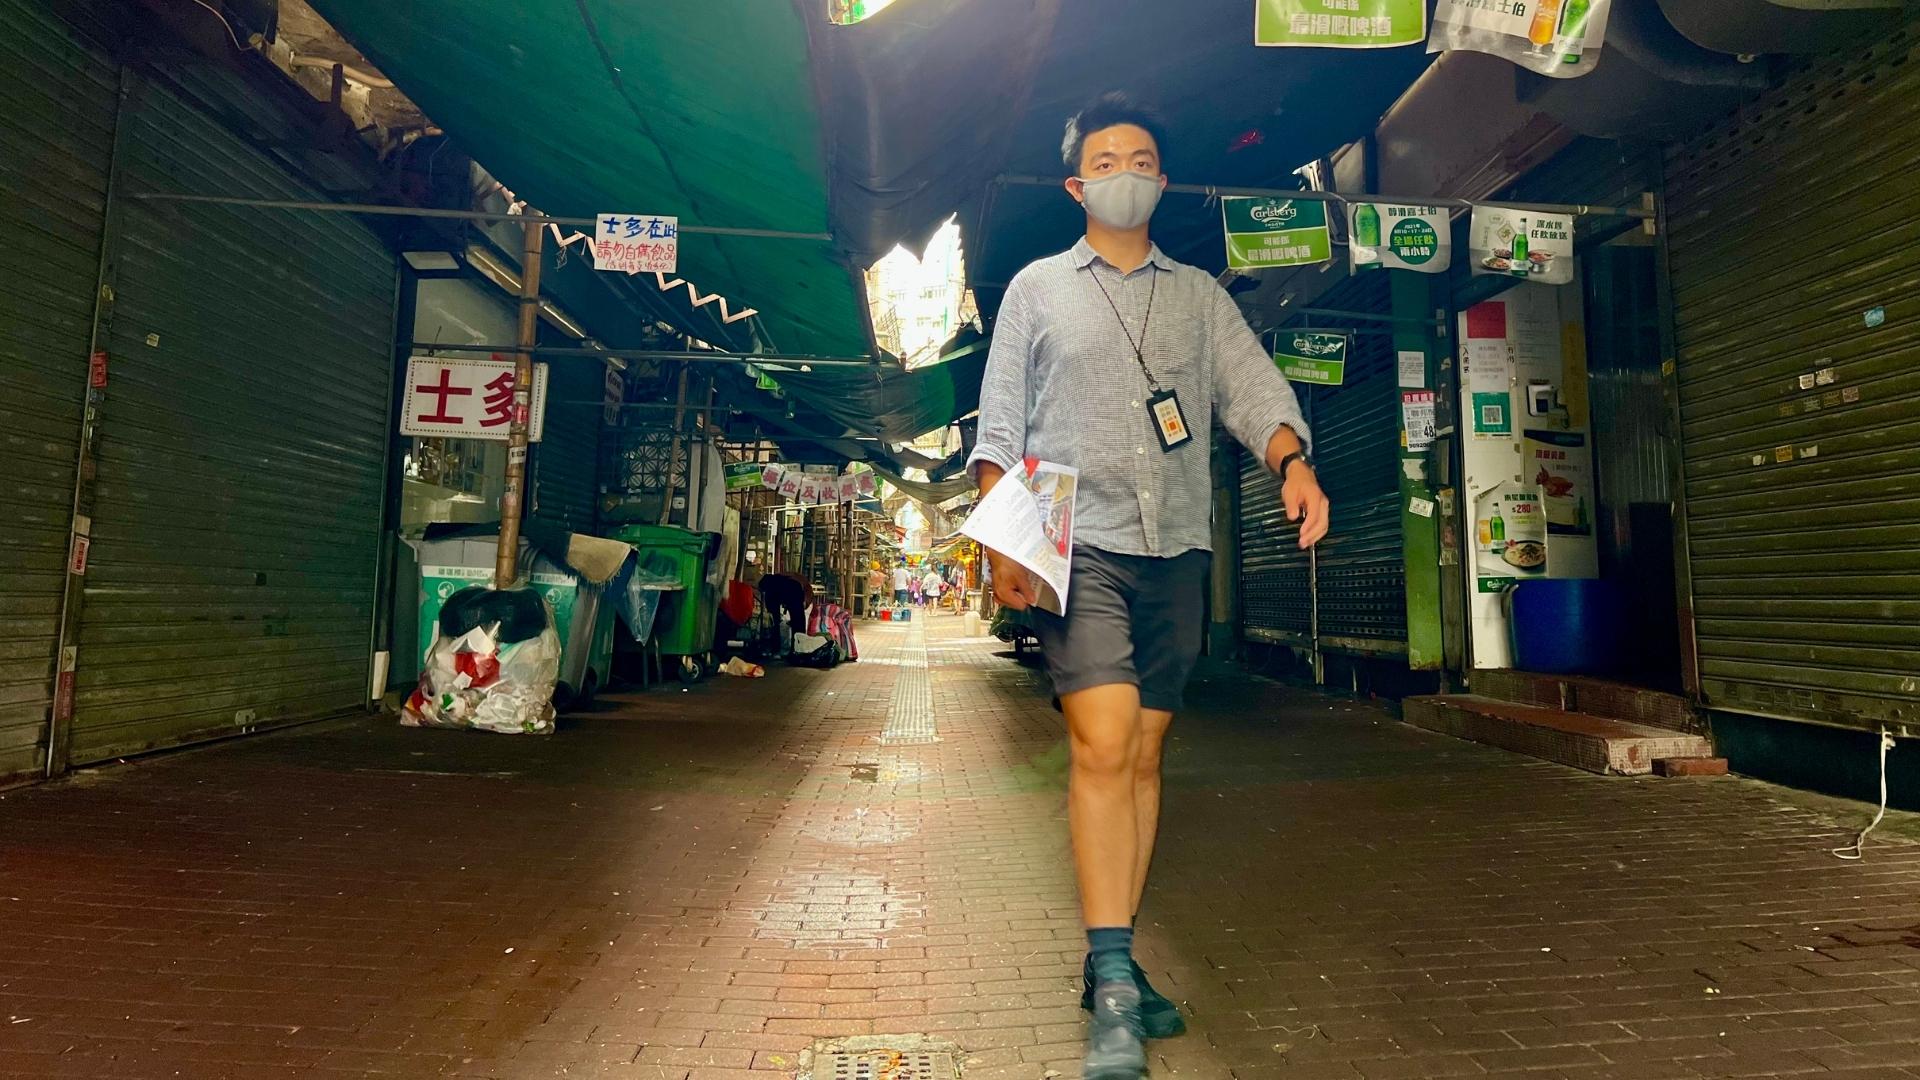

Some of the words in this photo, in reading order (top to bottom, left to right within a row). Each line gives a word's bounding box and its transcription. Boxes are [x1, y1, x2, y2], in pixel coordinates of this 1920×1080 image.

[1250, 206, 1297, 221] Carlsberg
[602, 217, 678, 239] 士多在此
[415, 369, 515, 428] 士多
